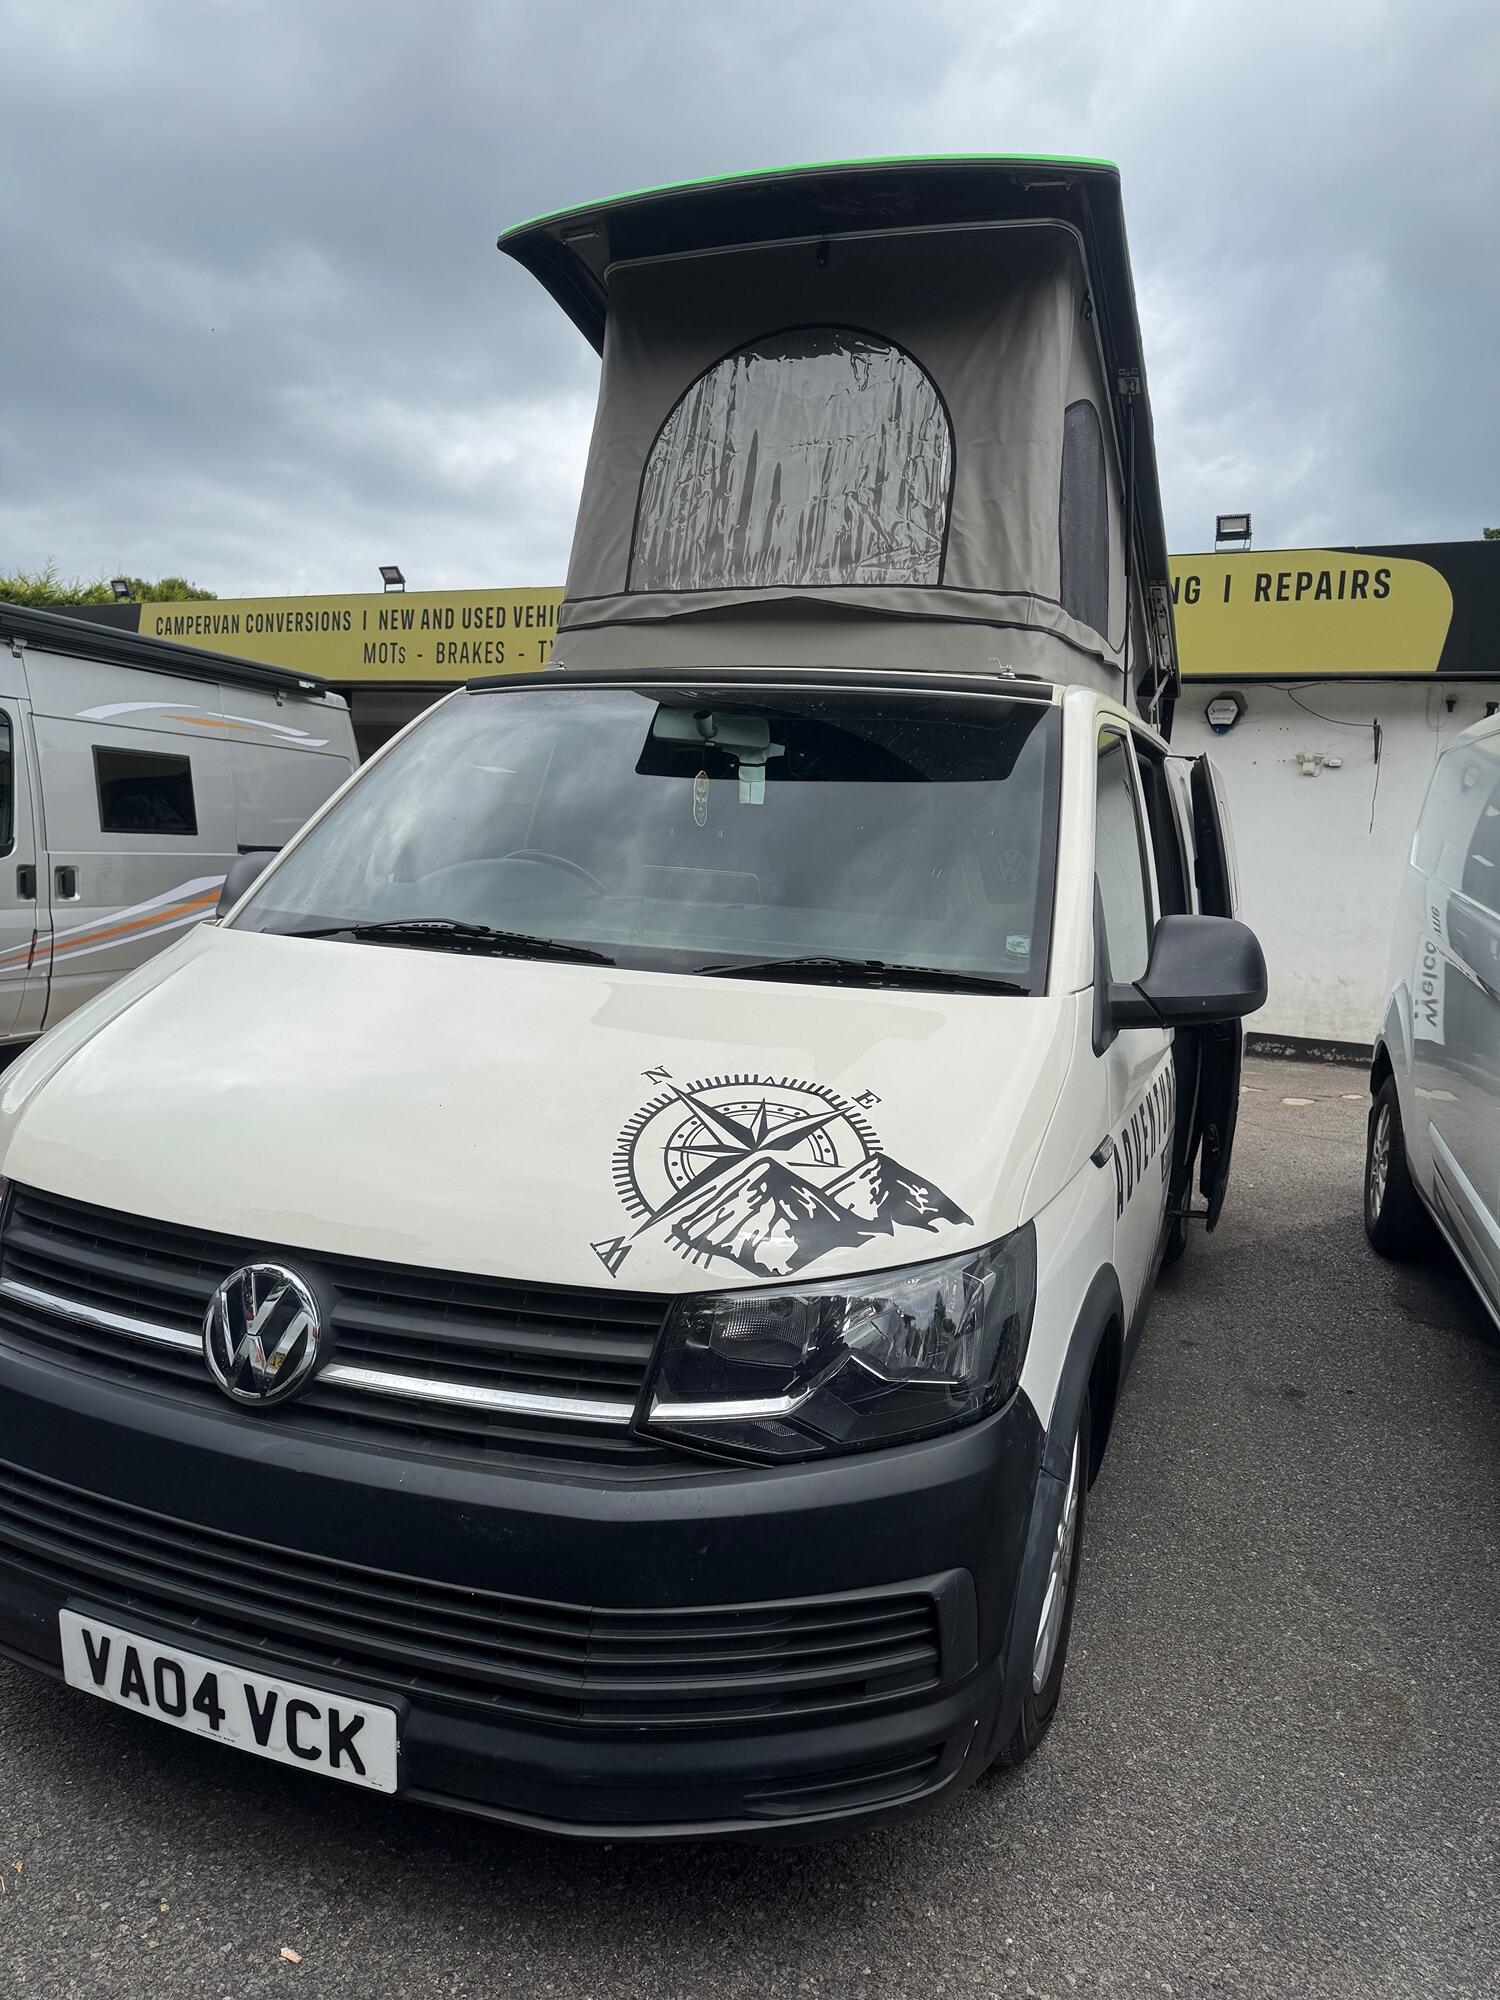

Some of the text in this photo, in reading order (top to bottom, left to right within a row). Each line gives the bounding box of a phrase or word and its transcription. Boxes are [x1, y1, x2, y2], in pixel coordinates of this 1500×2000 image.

[1254, 568, 1391, 602] REPAIRS
[156, 613, 240, 636] CAMPERVAN
[245, 609, 352, 634] CONVERSIONS
[378, 608, 415, 631] NEW
[420, 607, 455, 630] AND
[461, 605, 506, 629] USED
[363, 642, 406, 665] MOTs
[435, 640, 505, 664] BRAKES
[641, 1065, 673, 1086] N
[851, 1088, 882, 1111] E
[81, 1628, 367, 1777] VA04 VCK
